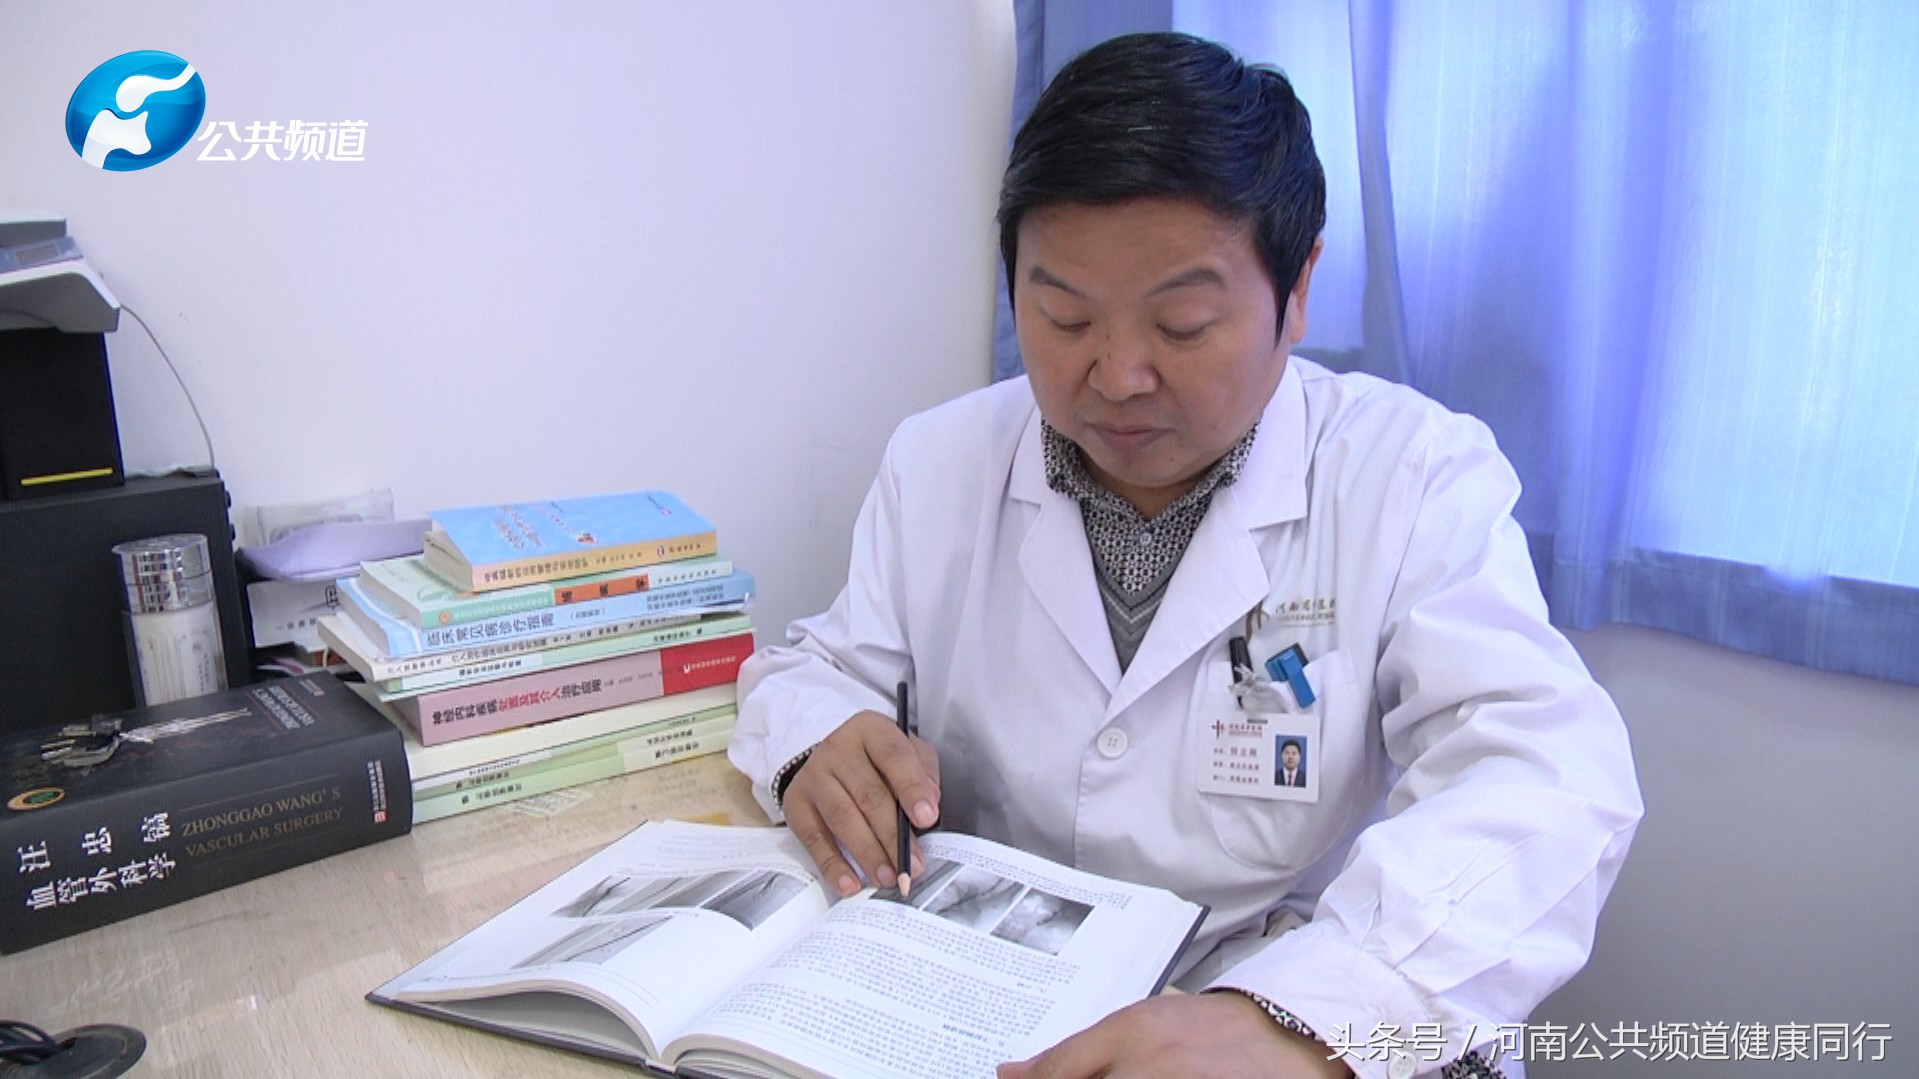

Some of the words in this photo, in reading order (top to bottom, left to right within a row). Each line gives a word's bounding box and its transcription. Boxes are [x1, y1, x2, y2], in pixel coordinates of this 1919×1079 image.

[427, 613, 554, 646] 临床常见病诊疗指南
[17, 812, 171, 874] 汪忠镐
[181, 802, 274, 837] ZHONGGAO
[185, 826, 270, 857] VASCULAR
[274, 807, 343, 835] SURGERY
[27, 852, 176, 911] 血管外科学
